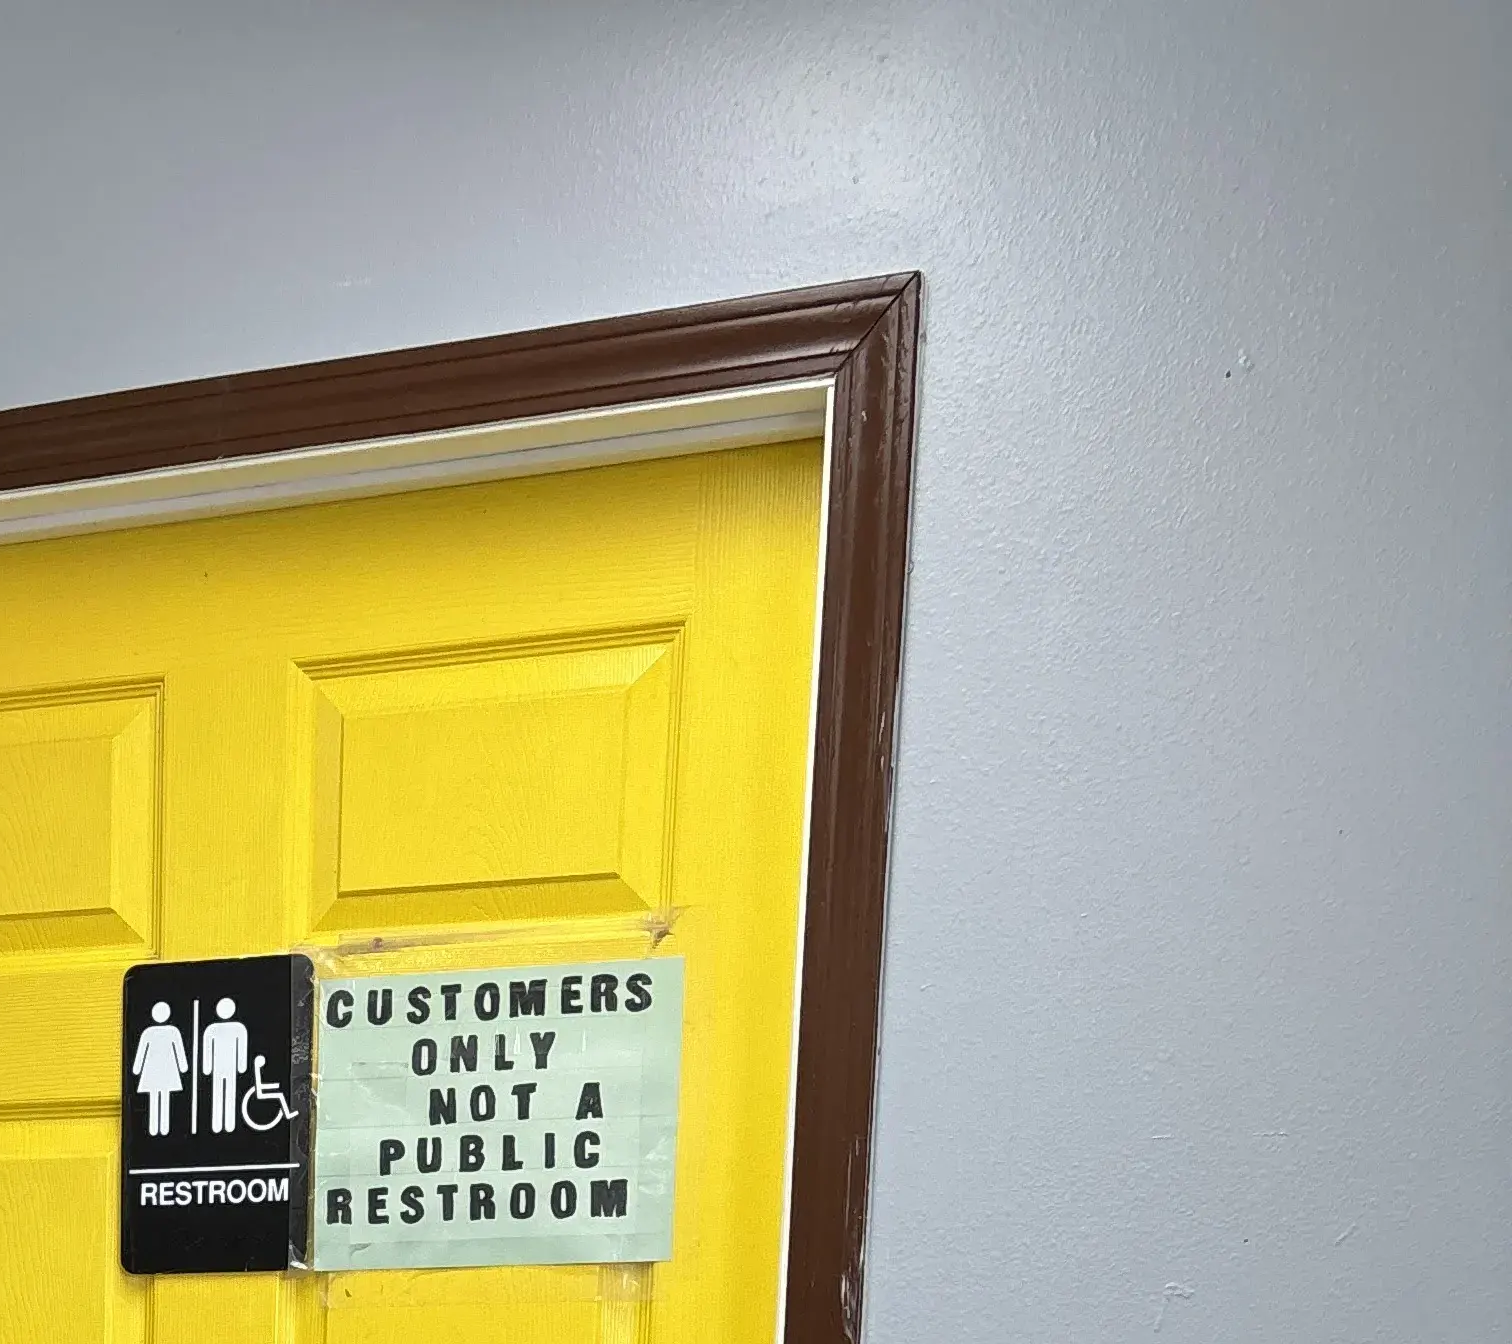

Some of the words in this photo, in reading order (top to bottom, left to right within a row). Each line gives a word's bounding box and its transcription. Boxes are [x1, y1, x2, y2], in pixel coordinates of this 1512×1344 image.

[326, 973, 653, 1028] CUSTOMERS
[412, 1032, 556, 1076] ONLY
[429, 1082, 537, 1125] NOT
[575, 1082, 603, 1120] A
[379, 1131, 601, 1176] PUBLIC
[140, 1178, 289, 1206] RESTROOM
[326, 1179, 628, 1225] RESTROOM
